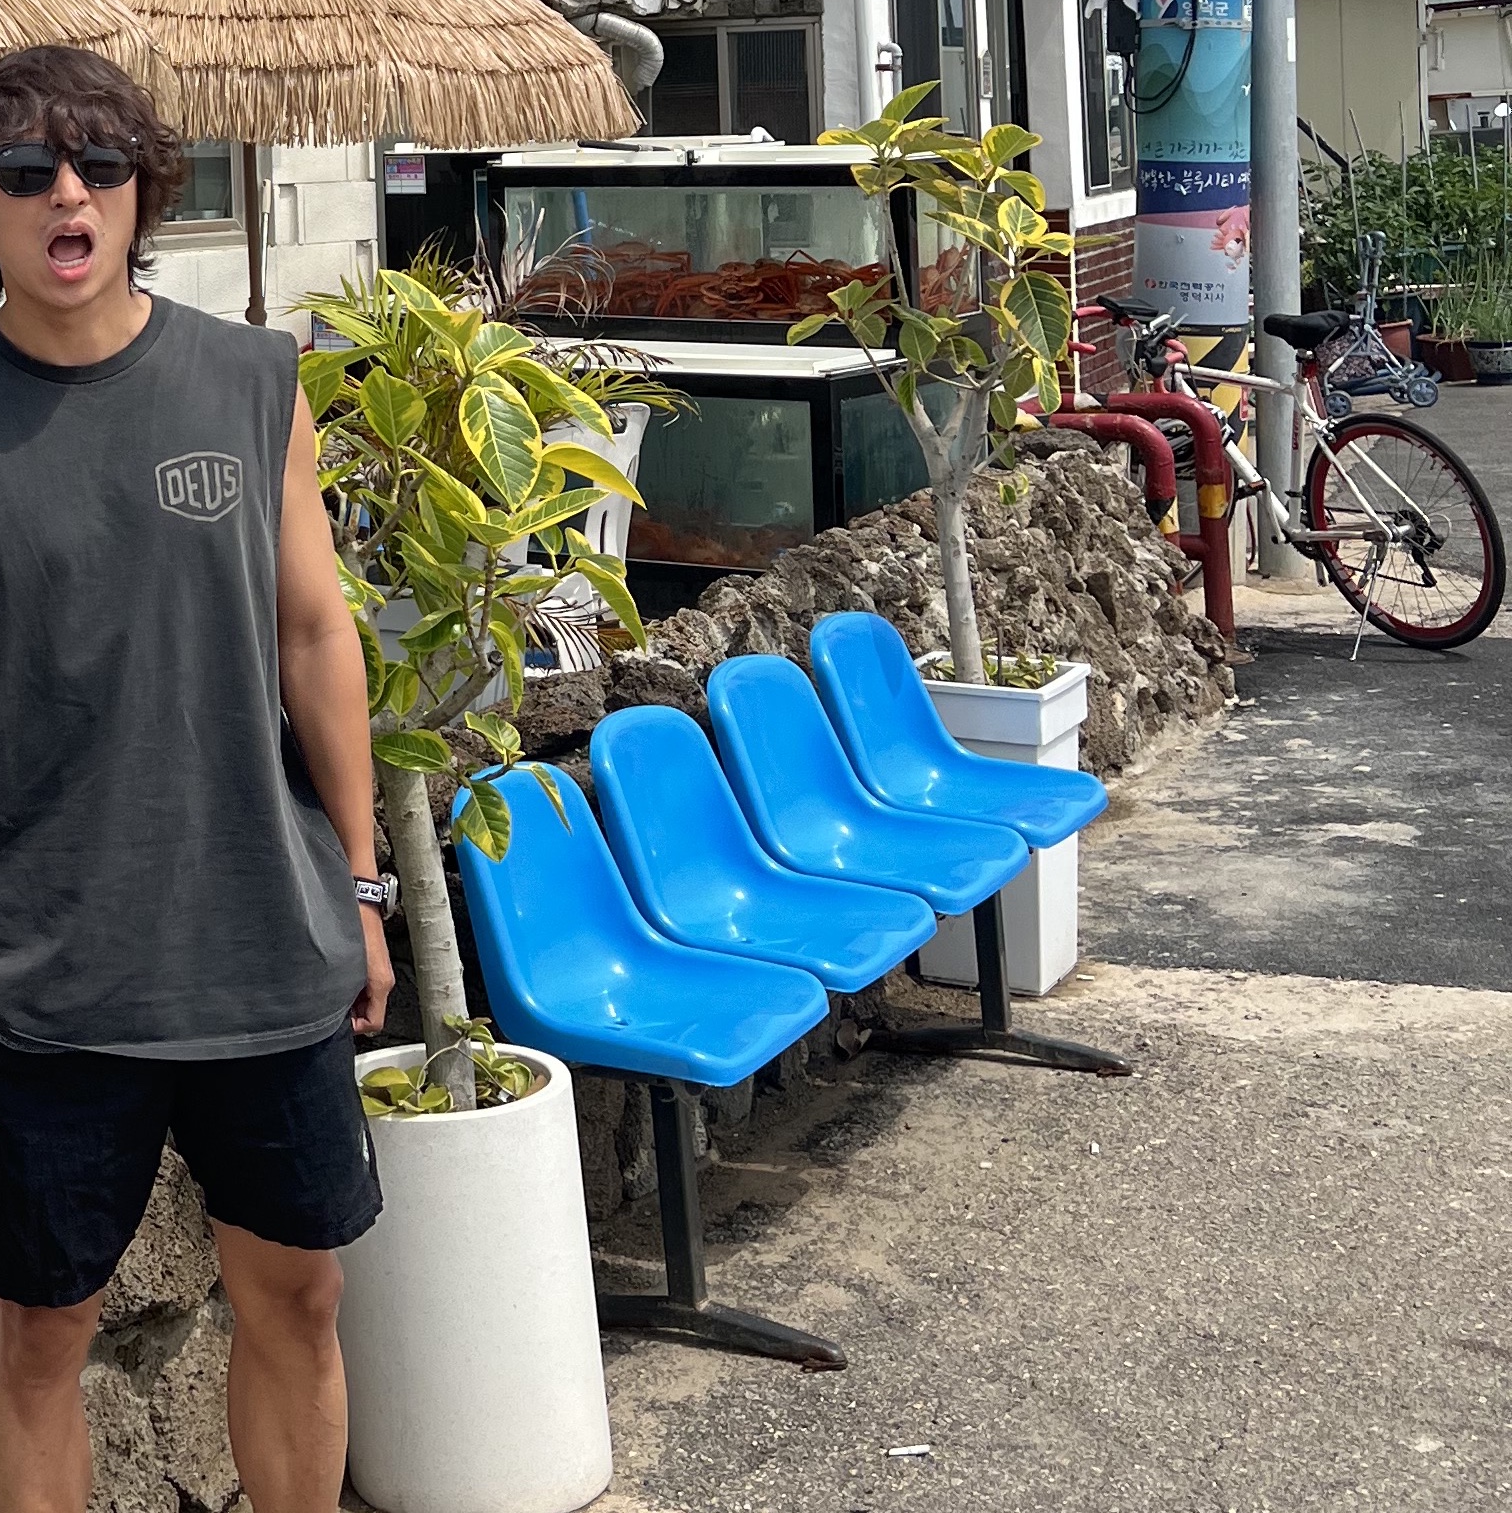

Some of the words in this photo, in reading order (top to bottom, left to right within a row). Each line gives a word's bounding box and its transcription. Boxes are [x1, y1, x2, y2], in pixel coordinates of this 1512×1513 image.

[1158, 280, 1225, 291] 한국전력공사
[1179, 291, 1225, 303] 영덕지사
[166, 460, 237, 511] DEUS
